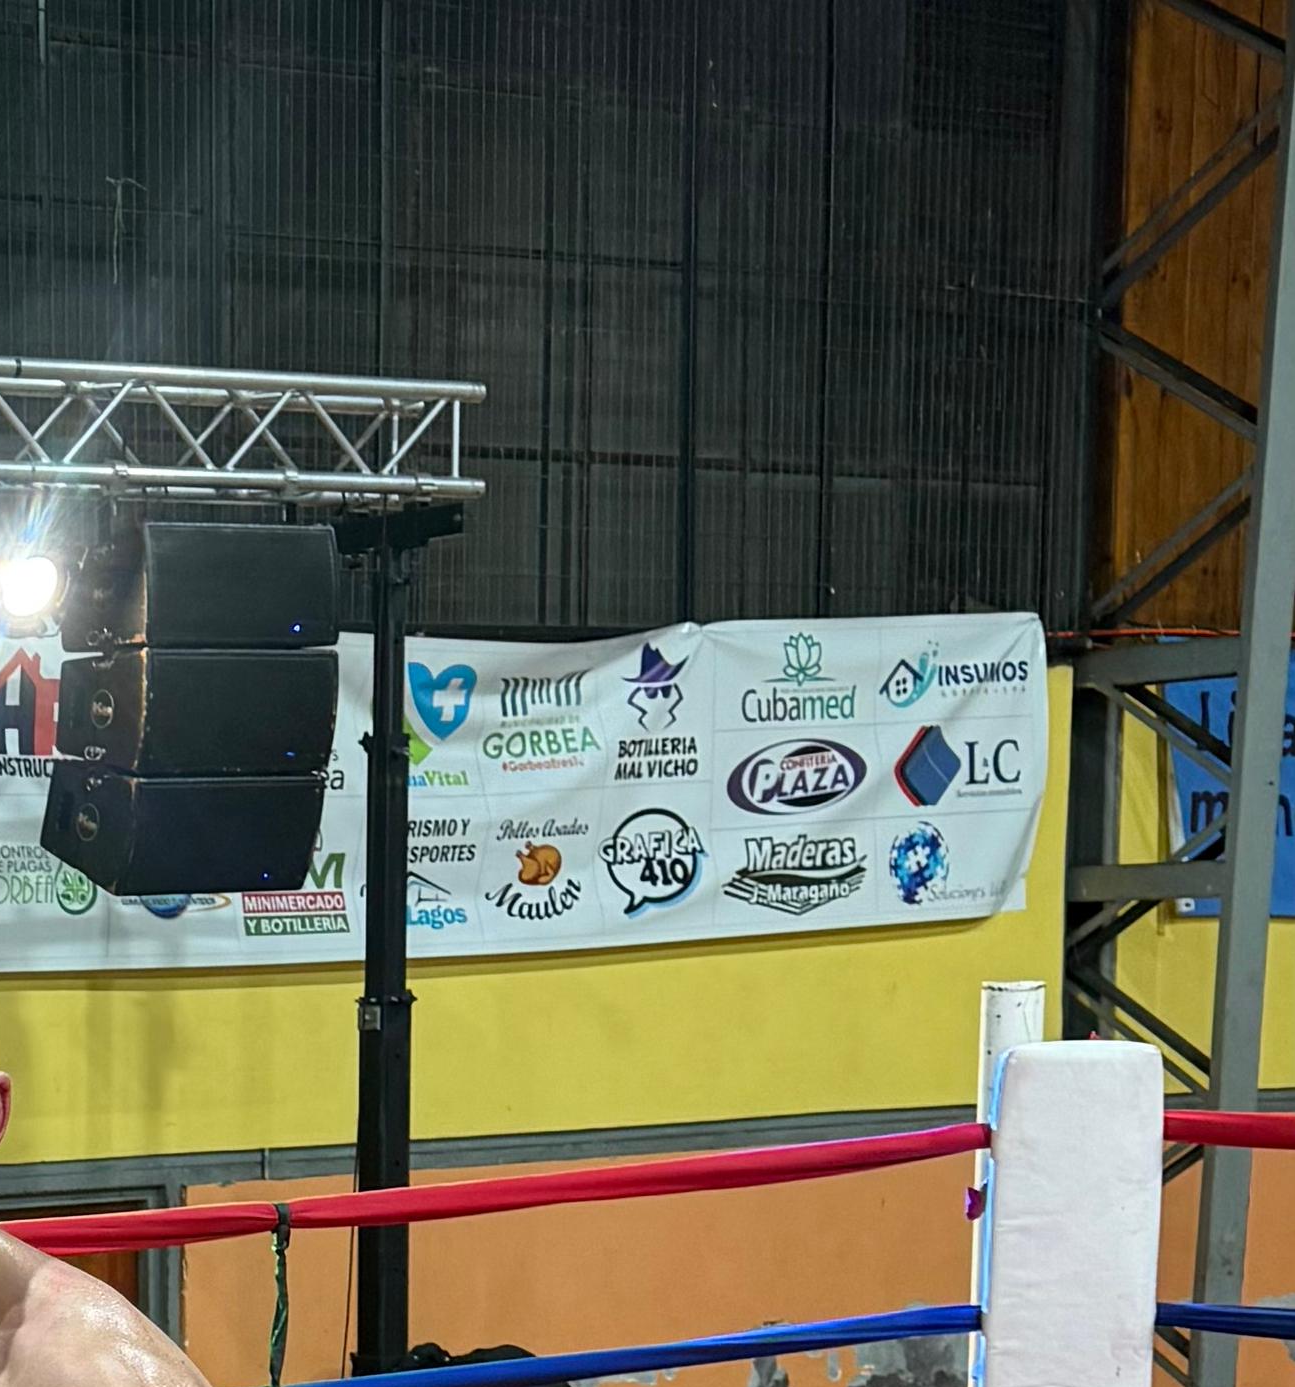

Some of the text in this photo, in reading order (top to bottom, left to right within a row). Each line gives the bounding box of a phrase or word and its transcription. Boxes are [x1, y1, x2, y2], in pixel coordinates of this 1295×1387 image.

[741, 685, 856, 724] Cubamed
[482, 726, 601, 760] GORBEA
[618, 736, 698, 759] BOTILLERIA
[614, 758, 699, 781] MAL VICHO
[749, 759, 851, 803] PLAZA
[407, 818, 471, 838] RISMO Y
[496, 817, 590, 841] Pollos Asados
[407, 844, 477, 864] SPORTES
[746, 836, 855, 871] Maderas
[6, 860, 53, 874] PLAGAS
[639, 858, 691, 887] 410
[244, 893, 344, 912] MINIMERCADO
[485, 878, 583, 920] Maulen
[246, 915, 348, 934] Y BOTILLERÍA
[406, 904, 468, 930] Lagos
